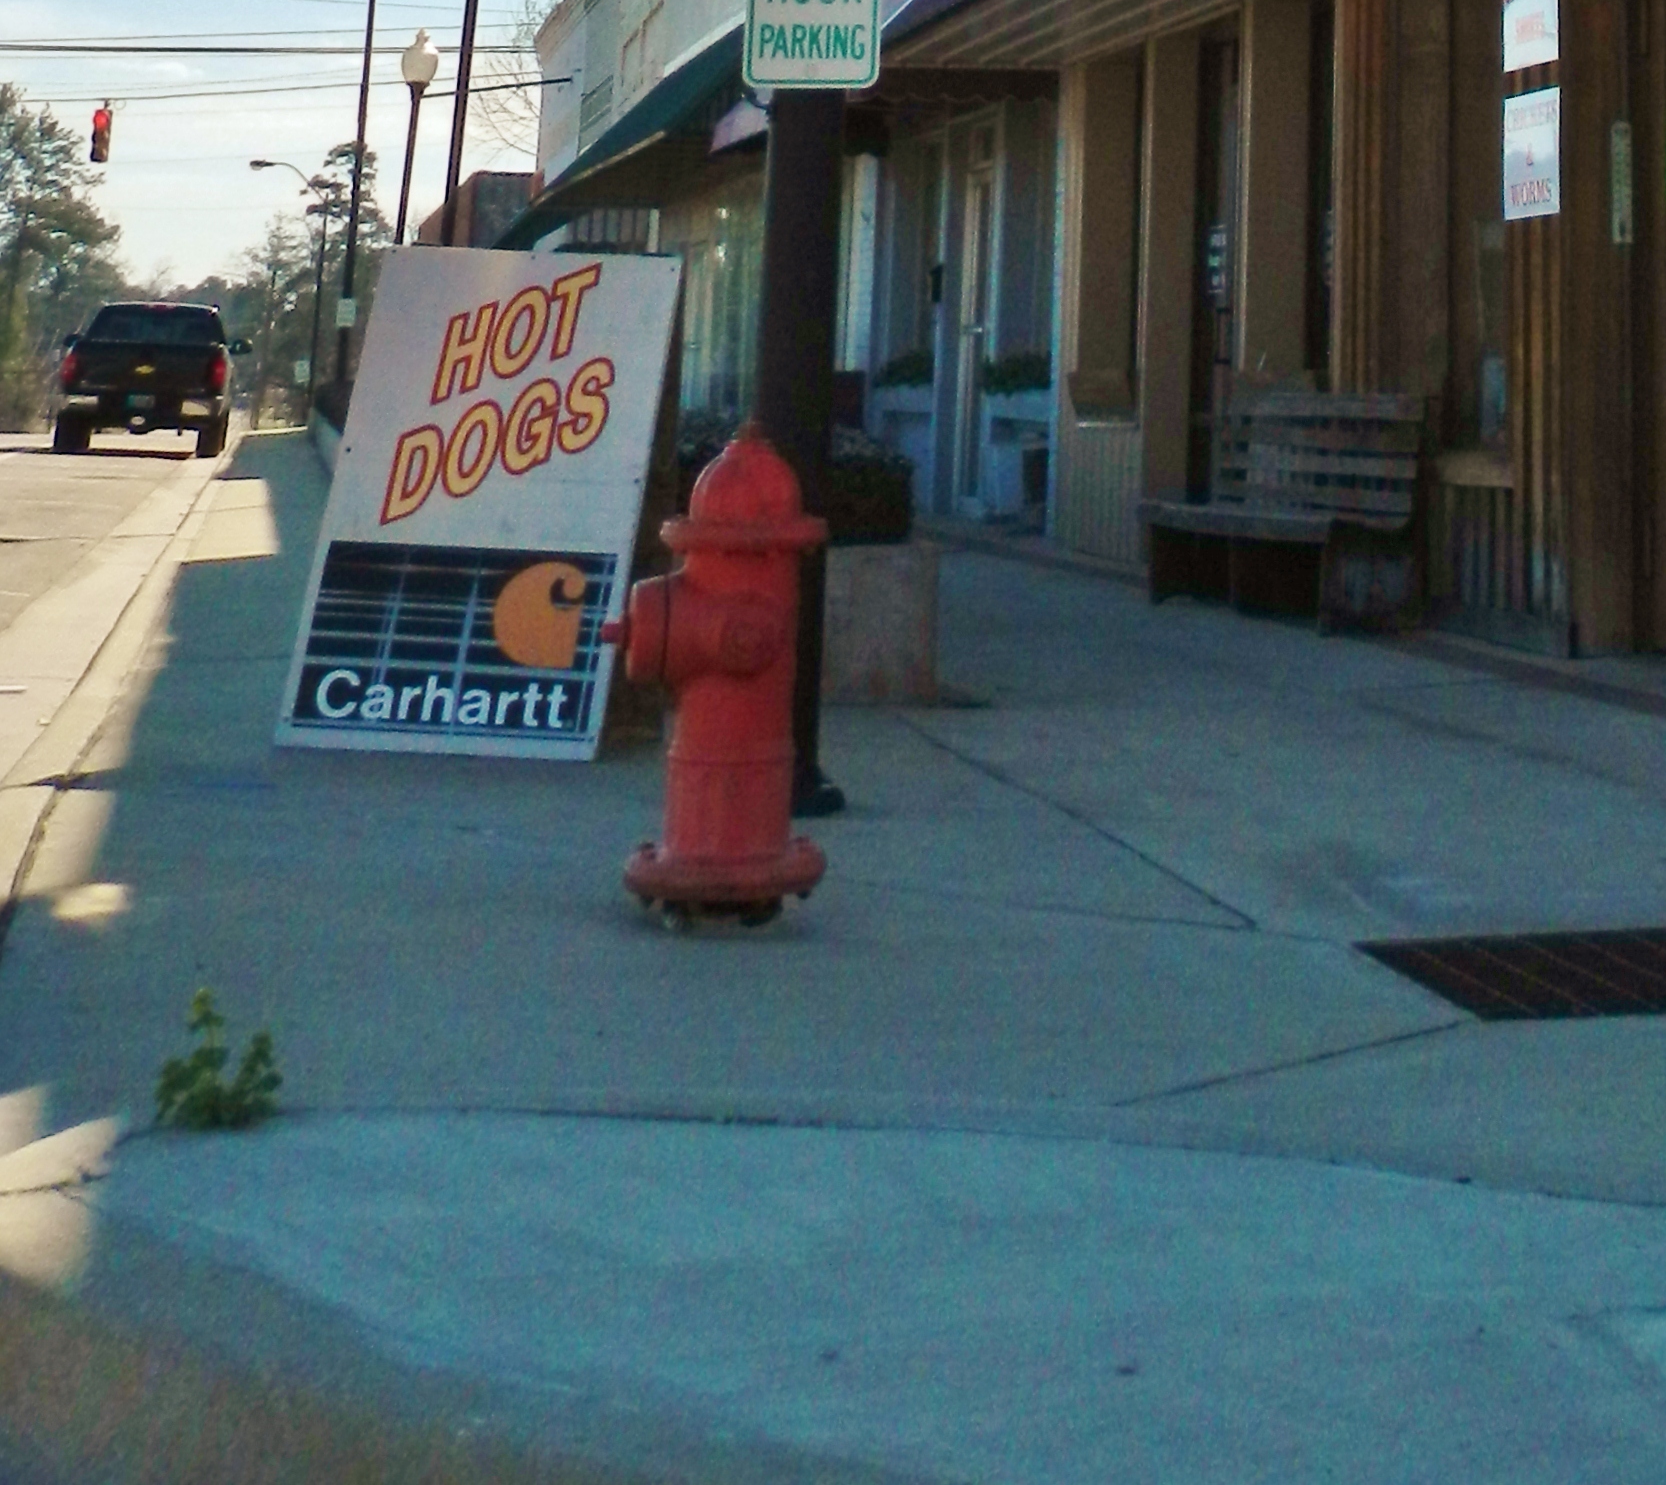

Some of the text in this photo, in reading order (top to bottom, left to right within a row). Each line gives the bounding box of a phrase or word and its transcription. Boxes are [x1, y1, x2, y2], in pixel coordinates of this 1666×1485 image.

[757, 23, 867, 61] PARKING
[430, 261, 603, 406] HOT
[378, 356, 616, 526] DOGS
[315, 667, 568, 729] Carhartt
